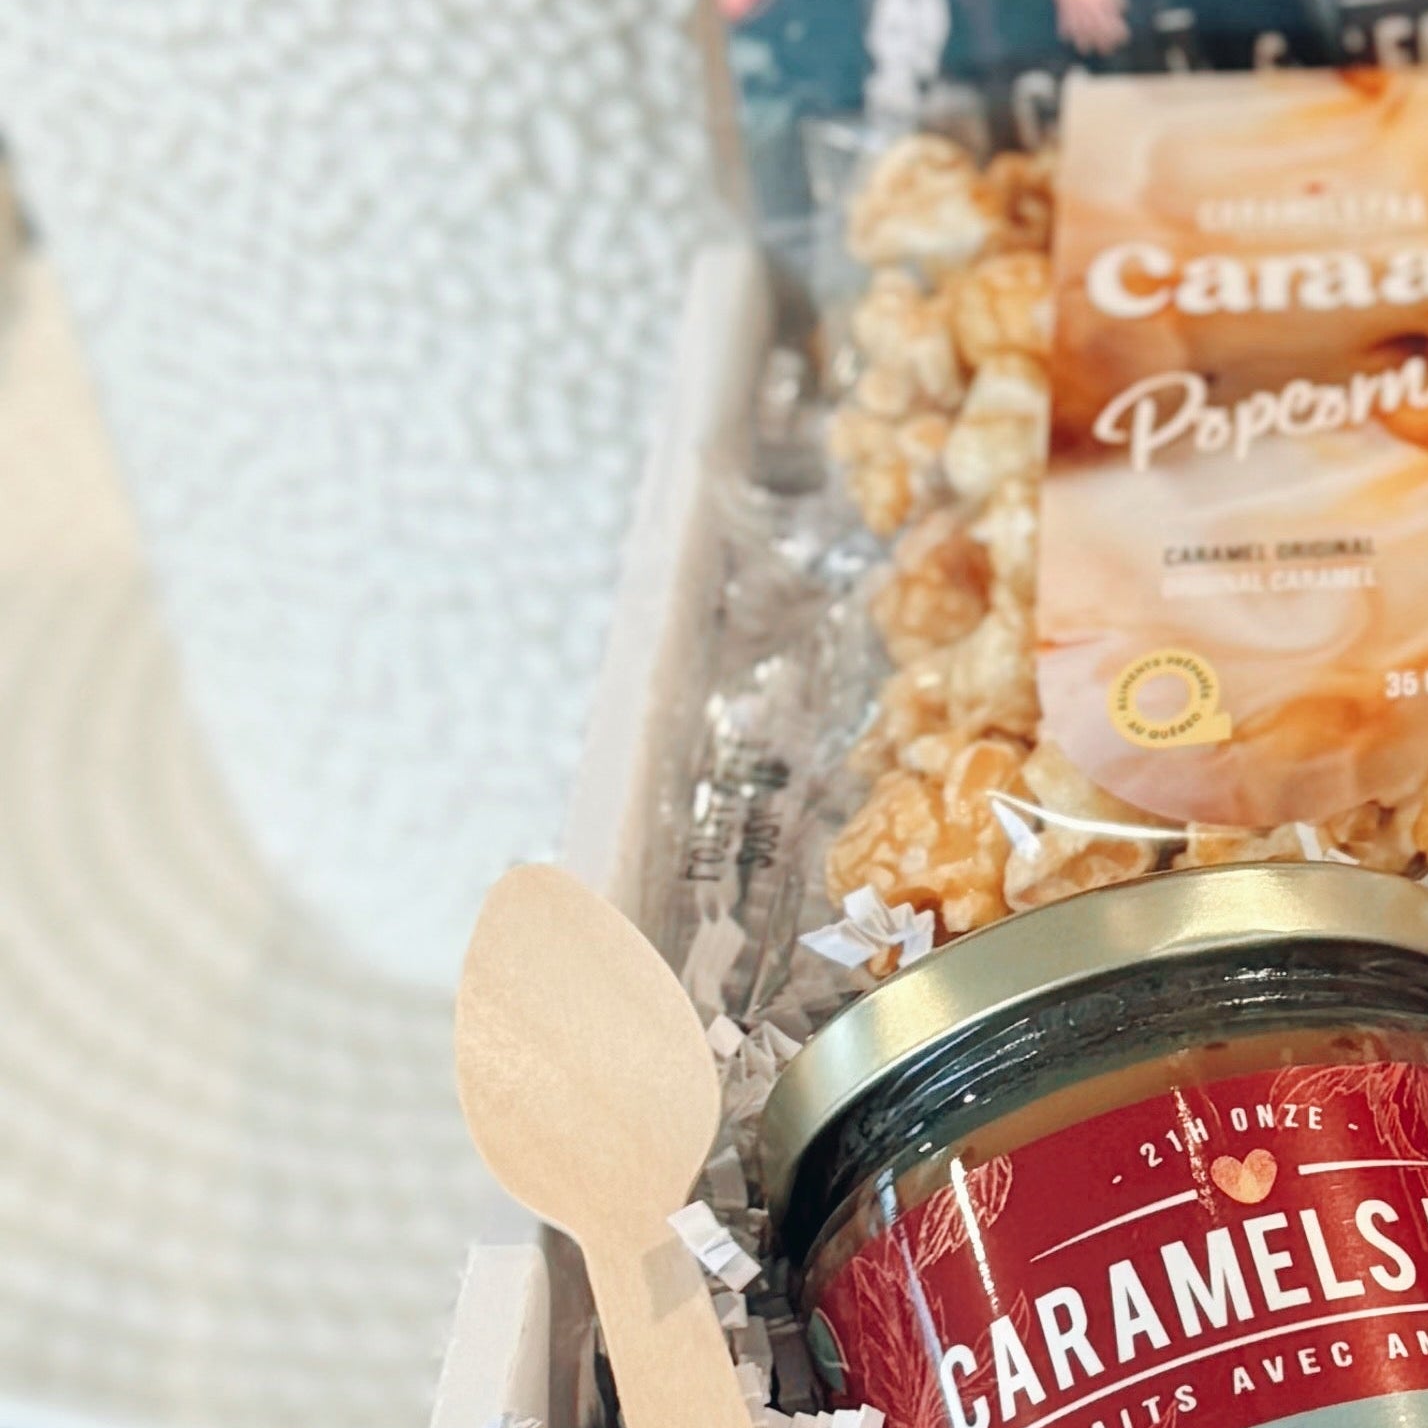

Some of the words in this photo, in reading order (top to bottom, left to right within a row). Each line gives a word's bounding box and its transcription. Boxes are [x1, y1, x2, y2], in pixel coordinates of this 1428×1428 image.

[1164, 545, 1267, 566] CARAMEL
[1275, 537, 1377, 560] ORIGINAL
[1385, 671, 1418, 700] 35
[1140, 1117, 1210, 1167] 21H
[1230, 1103, 1324, 1132] ONZE
[1231, 1341, 1354, 1396] AVEC
